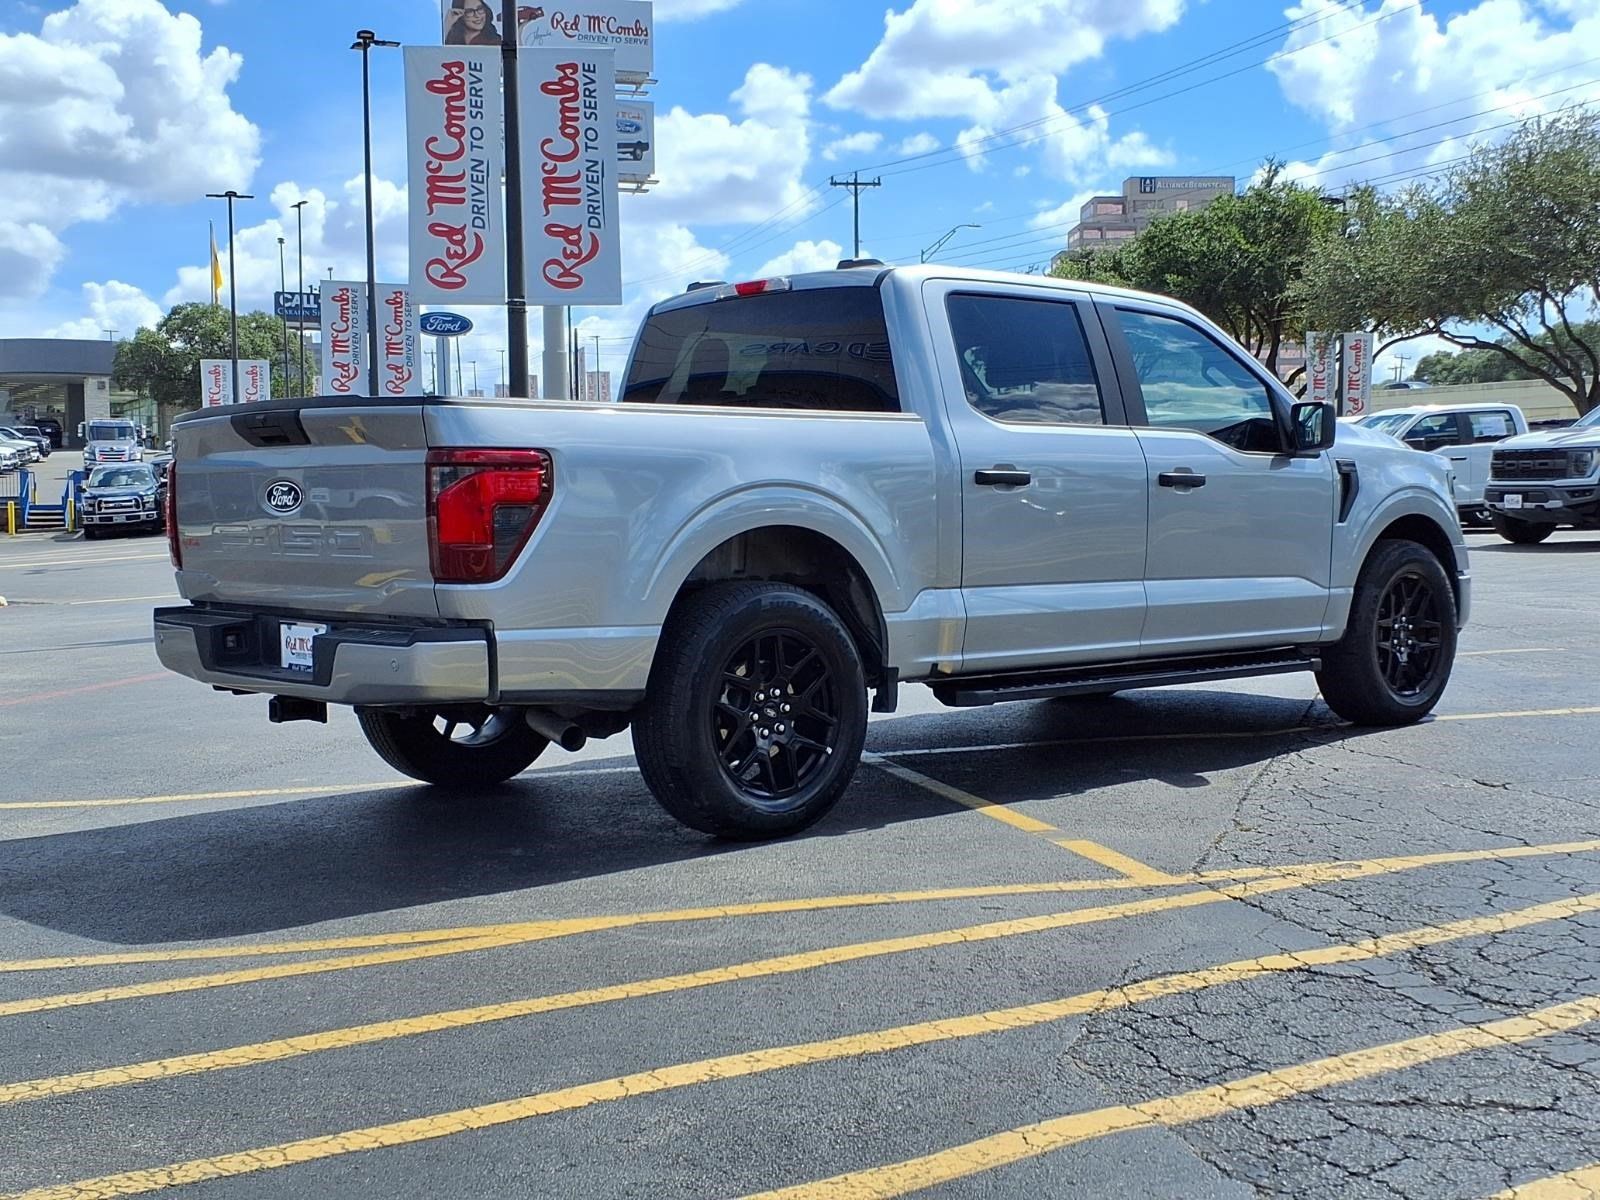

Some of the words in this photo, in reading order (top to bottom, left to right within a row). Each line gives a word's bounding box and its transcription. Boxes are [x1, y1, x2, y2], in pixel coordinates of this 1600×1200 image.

[551, 11, 580, 38] Red
[583, 14, 648, 37] McCombs
[578, 34, 608, 42] DRIVEN
[624, 38, 648, 46] SERVE
[468, 61, 484, 120] SERVE
[582, 62, 598, 122] SERVE
[425, 60, 466, 216] McCombs
[470, 126, 484, 152] TO
[540, 62, 582, 216] McCombs
[584, 126, 599, 152] TO
[472, 158, 486, 230] DRIVEN
[586, 159, 602, 229] DRIVEN
[425, 222, 484, 290] Red
[542, 222, 600, 290] Red
[331, 288, 350, 358] McCombs
[352, 318, 358, 330] TO
[385, 291, 404, 360] McCombs
[405, 320, 412, 332] TO
[426, 316, 461, 331] Ford
[331, 362, 358, 392] Red
[385, 364, 412, 394] Red
[271, 486, 295, 506] Ford
